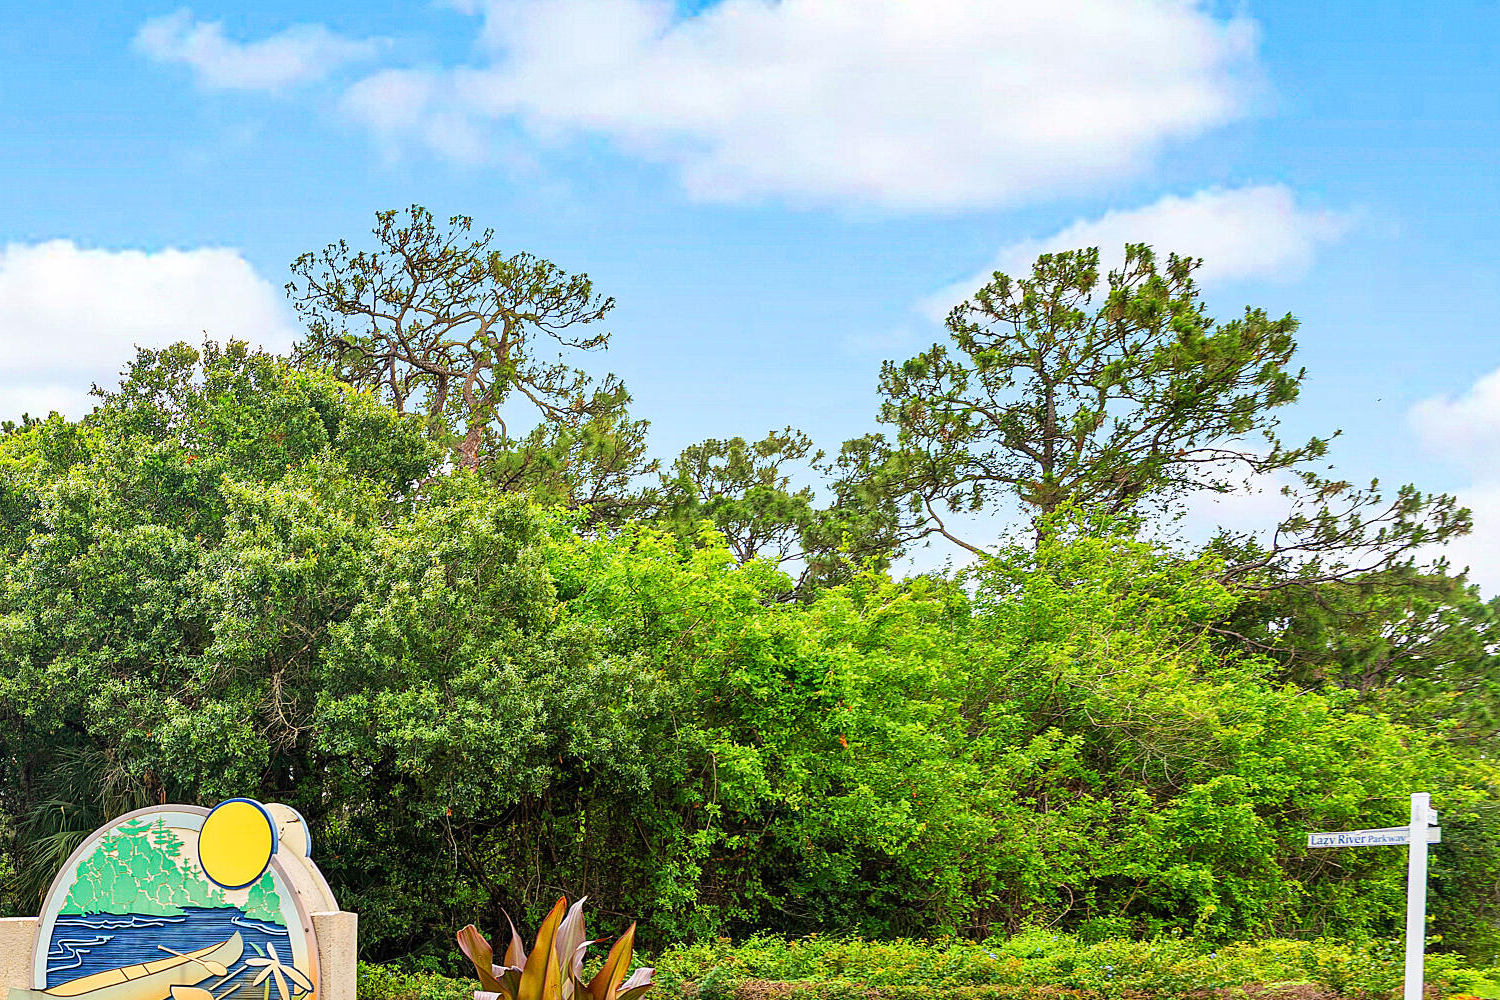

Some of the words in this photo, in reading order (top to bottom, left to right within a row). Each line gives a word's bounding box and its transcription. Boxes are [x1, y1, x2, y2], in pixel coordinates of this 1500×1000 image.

[1311, 835, 1335, 846] Lazy
[1338, 834, 1366, 844] River
[1368, 834, 1405, 843] Parkway
